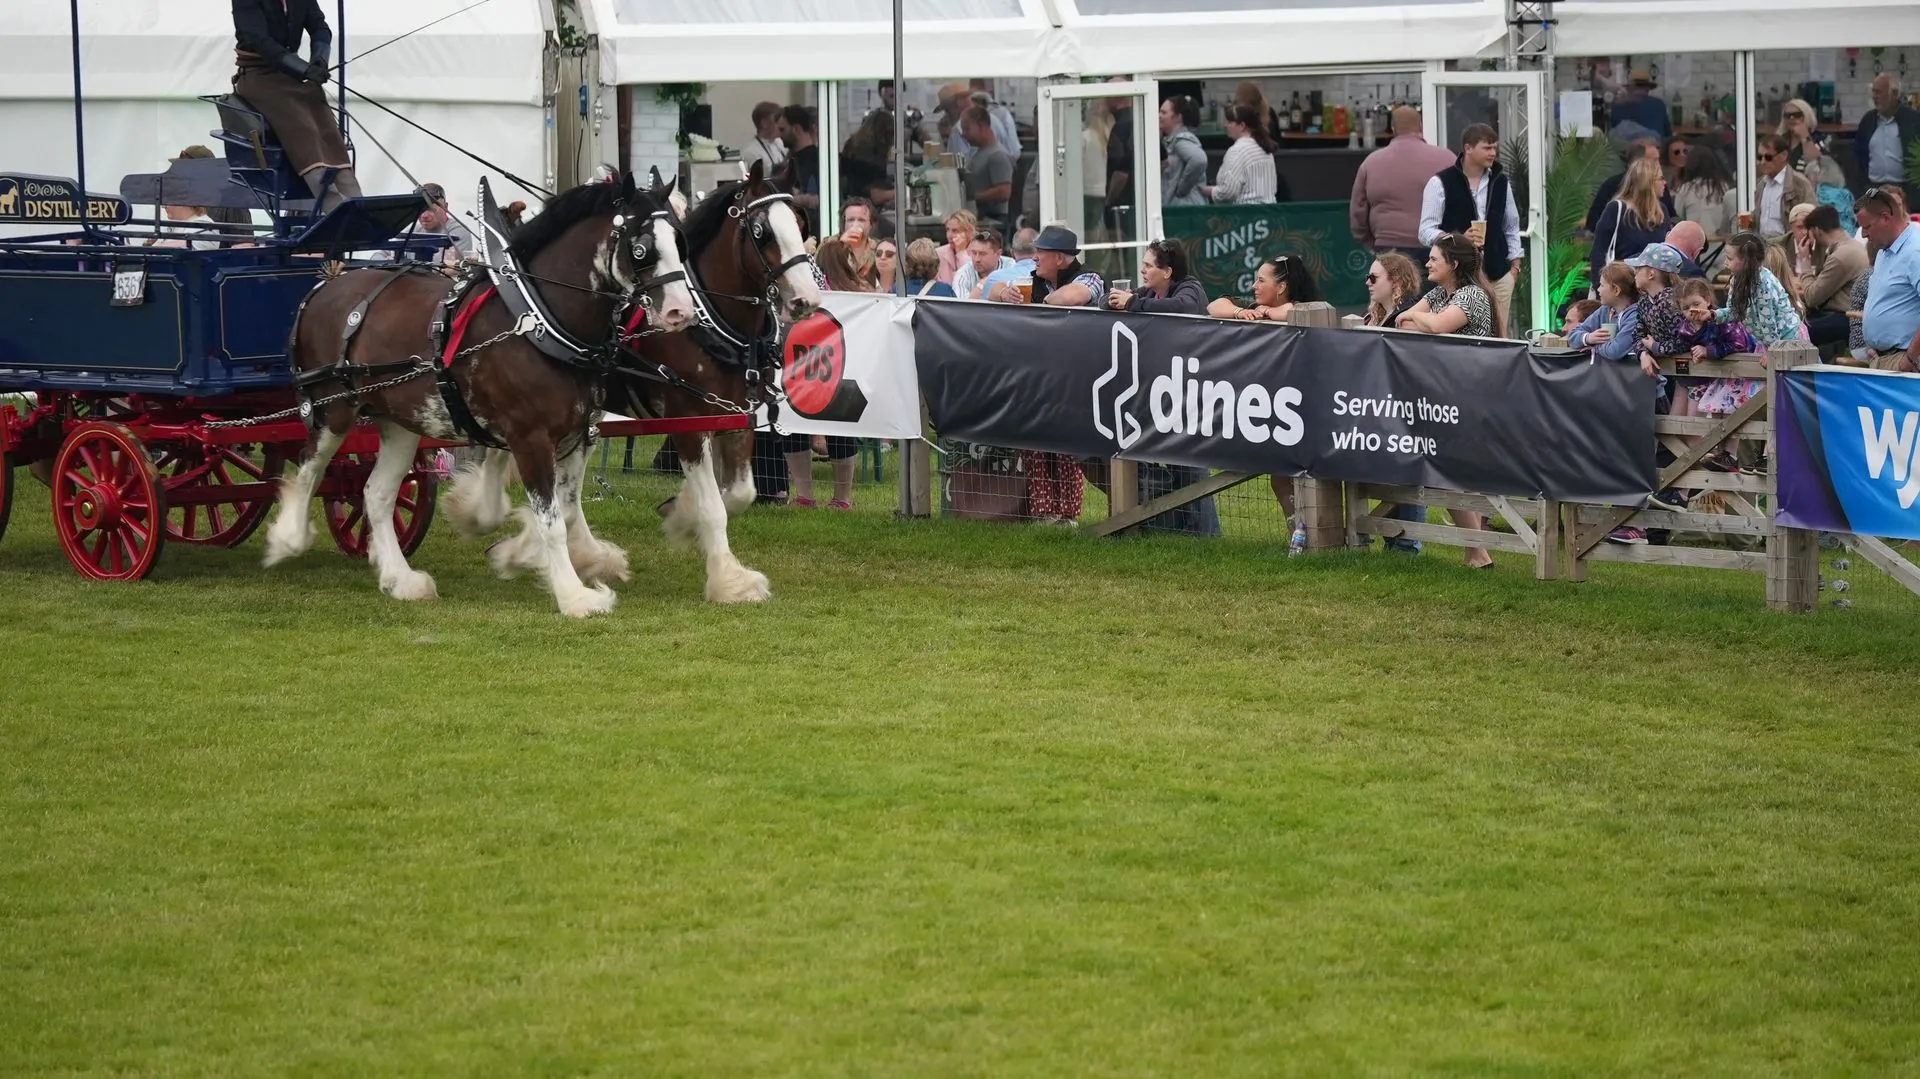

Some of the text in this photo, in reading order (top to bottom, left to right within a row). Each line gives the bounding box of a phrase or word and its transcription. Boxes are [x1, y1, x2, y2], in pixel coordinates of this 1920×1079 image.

[25, 200, 120, 218] DISTILERY
[1205, 219, 1269, 258] INNIS
[1245, 247, 1262, 269] &
[790, 344, 834, 382] PDS
[1150, 356, 1304, 446] dines
[1332, 390, 1460, 425] Serving those
[1331, 427, 1437, 456] who serve
